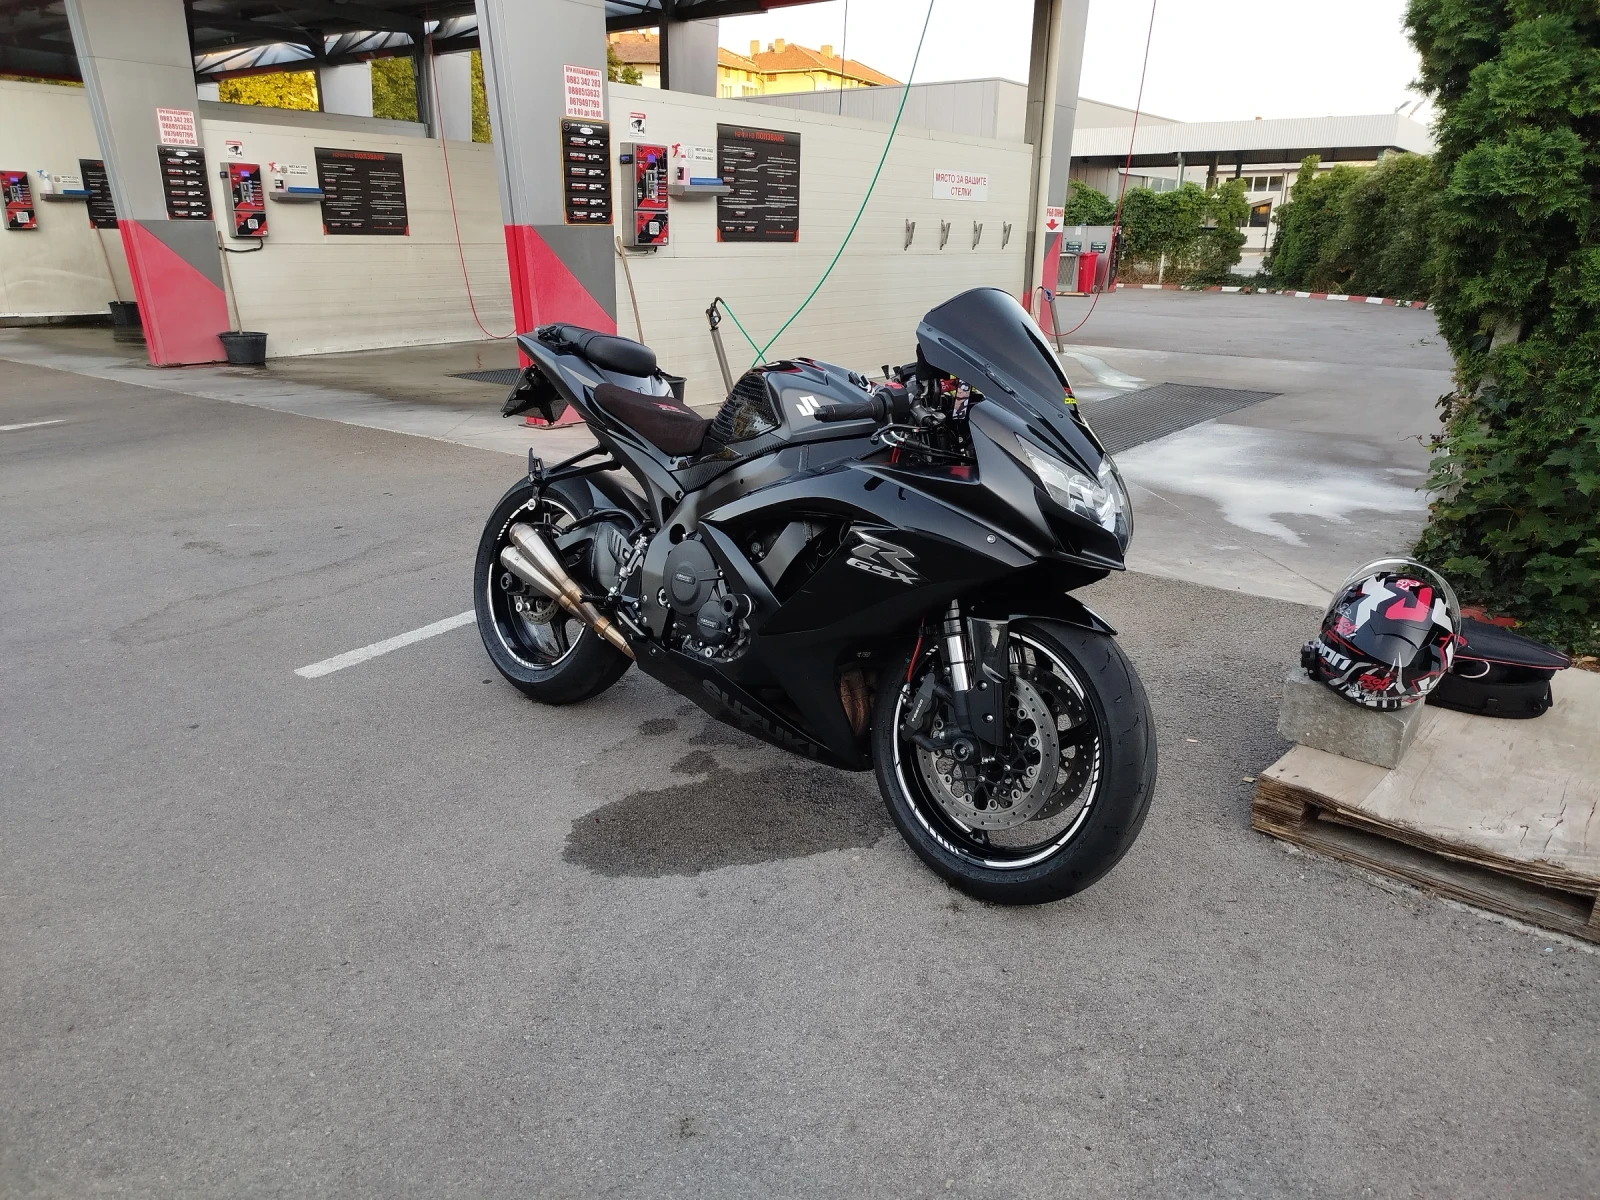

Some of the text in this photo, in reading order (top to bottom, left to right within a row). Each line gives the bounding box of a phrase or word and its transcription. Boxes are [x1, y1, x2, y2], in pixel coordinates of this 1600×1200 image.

[936, 173, 986, 186] МЯСТО ЗА ВАШИТЕ
[846, 558, 920, 585] GSX
[702, 679, 818, 759] SUZUKI
